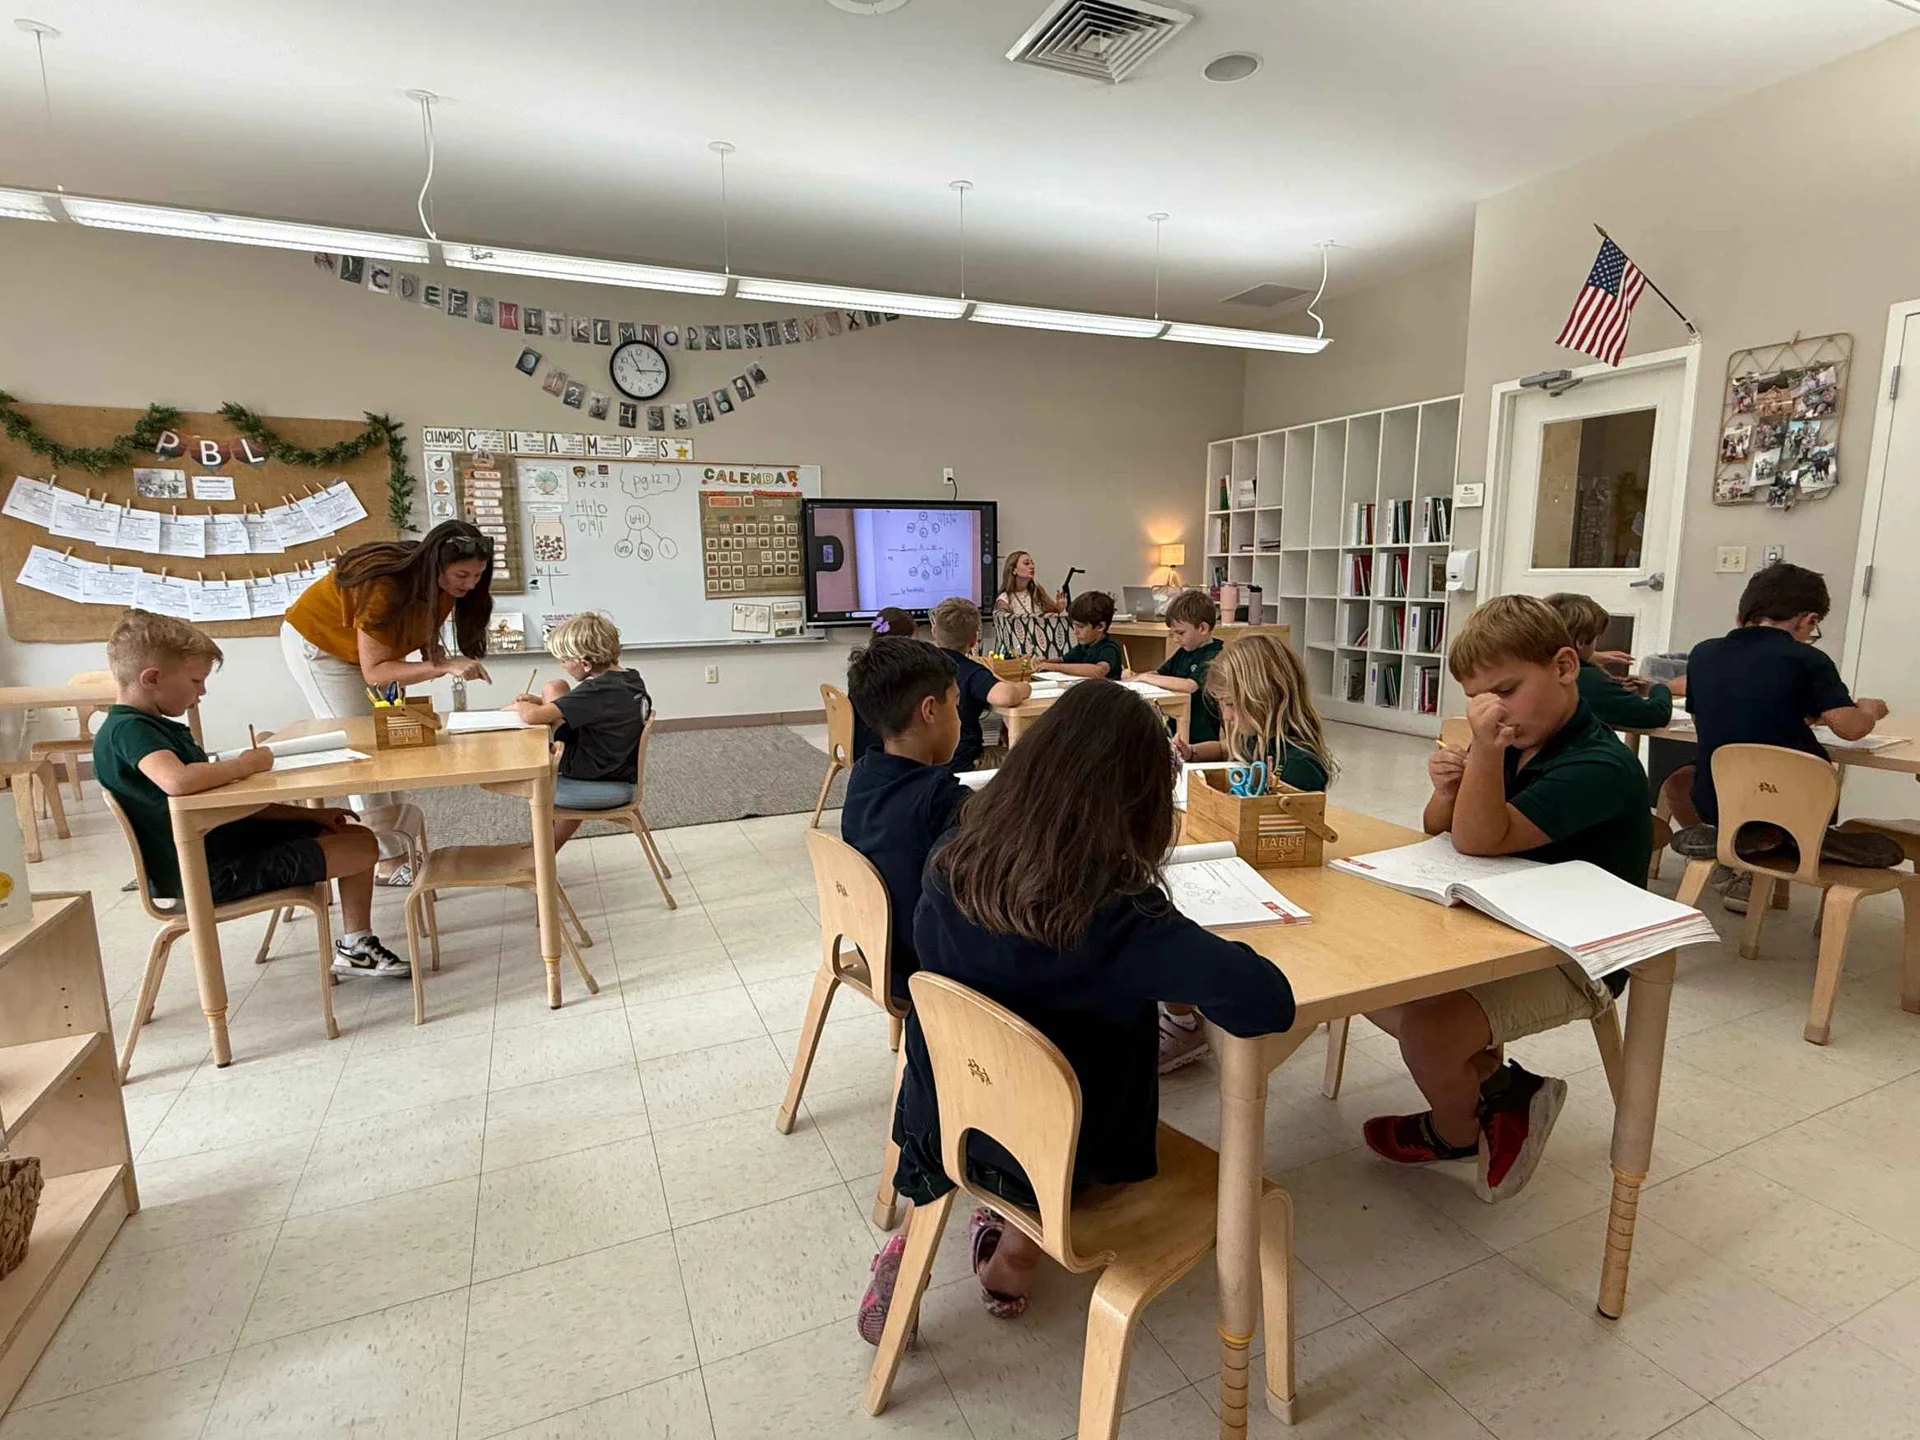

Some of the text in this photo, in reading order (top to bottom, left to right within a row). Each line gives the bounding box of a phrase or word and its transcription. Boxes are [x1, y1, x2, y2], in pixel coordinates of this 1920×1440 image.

[371, 268, 390, 289] C
[401, 275, 415, 298] D
[425, 285, 441, 305] E
[451, 293, 465, 313] F
[501, 303, 517, 328] H
[527, 309, 540, 331] I
[572, 317, 590, 338] K
[597, 321, 609, 343] L
[620, 327, 636, 344] M
[643, 328, 659, 347] N
[663, 330, 679, 346] O
[687, 326, 698, 350] P
[726, 327, 739, 346] R
[747, 326, 758, 347] S
[765, 326, 778, 345] T
[783, 319, 799, 342] U
[846, 310, 860, 330] X
[618, 365, 624, 373] 9
[653, 359, 659, 367] 2
[621, 374, 628, 383] 8
[567, 386, 580, 405] 2
[620, 405, 633, 426] 4
[650, 409, 663, 428] 5
[697, 402, 708, 420] 7
[736, 378, 750, 399] 9
[425, 430, 463, 444] CHAMPS
[155, 430, 265, 466] P B L
[467, 431, 477, 451] C
[508, 432, 518, 452] H
[549, 434, 559, 454] A
[587, 436, 598, 455] M
[624, 438, 632, 456] P
[660, 439, 668, 458] S
[703, 467, 799, 485] CALENDAR
[600, 481, 608, 489] 31
[632, 473, 671, 493] pg 127
[630, 513, 645, 525] 641
[535, 566, 561, 575] W L
[502, 642, 518, 650] Boy
[1260, 836, 1304, 848] TABLE
[1277, 849, 1285, 861] 3
